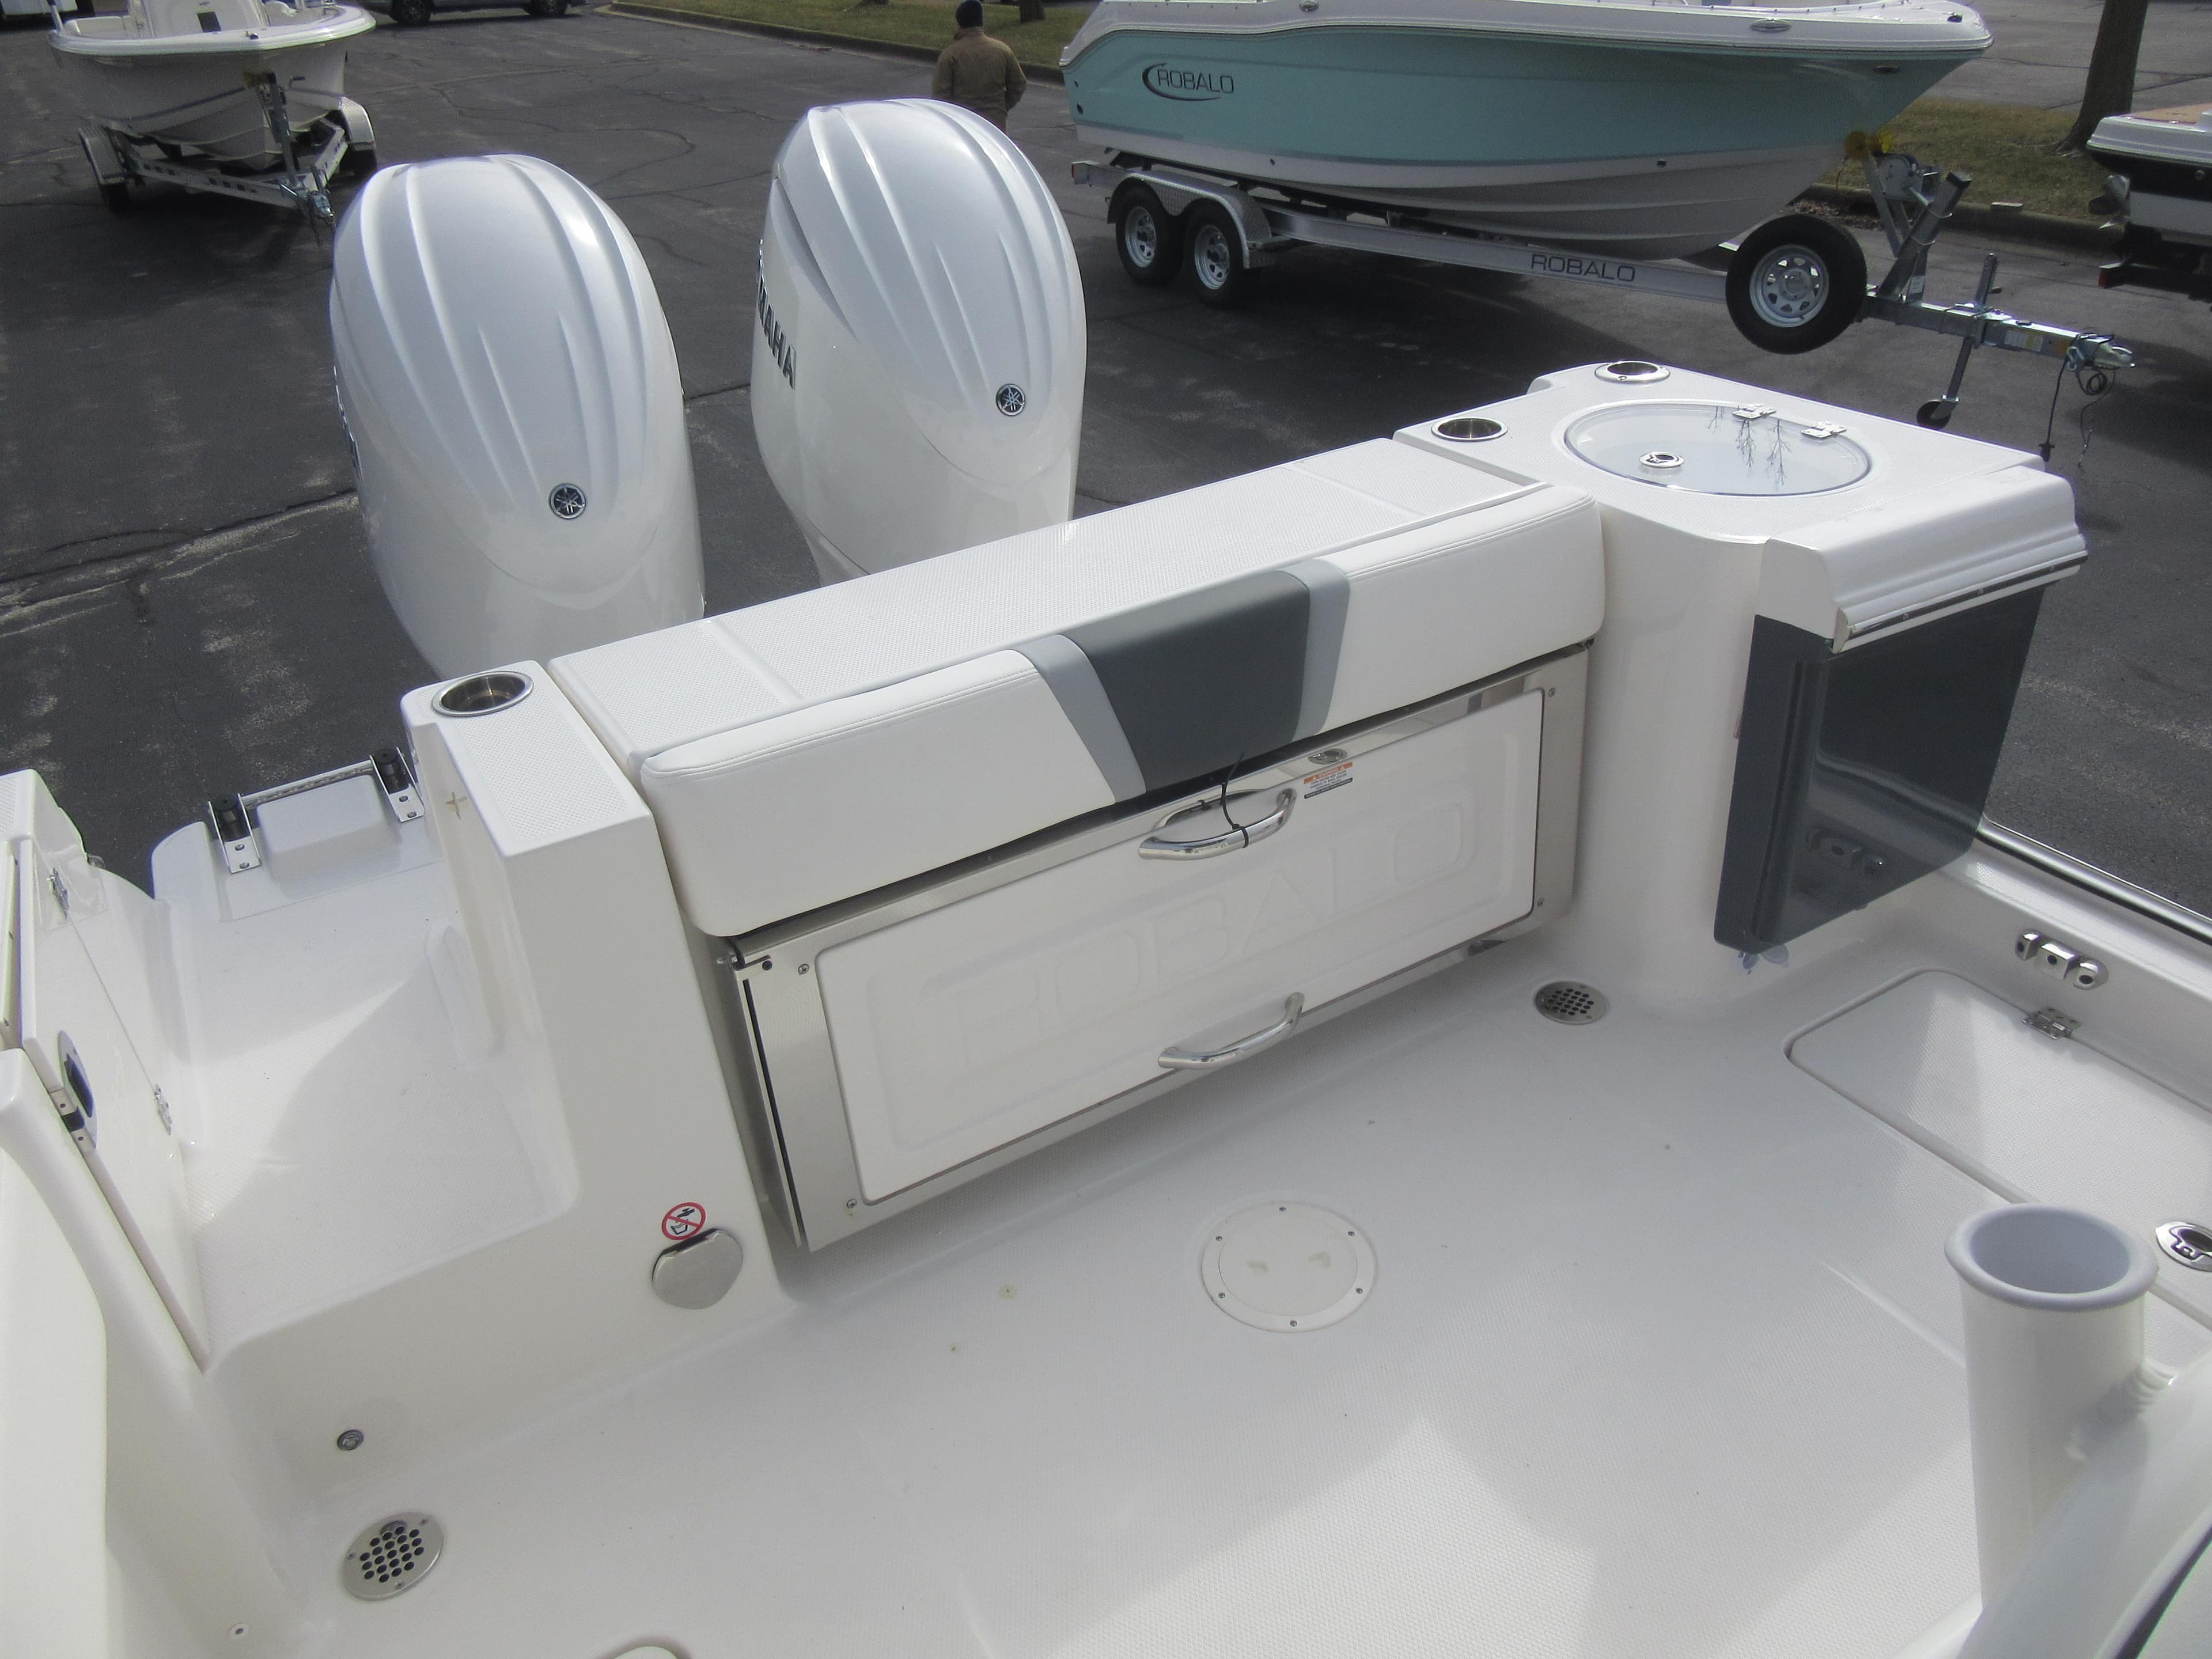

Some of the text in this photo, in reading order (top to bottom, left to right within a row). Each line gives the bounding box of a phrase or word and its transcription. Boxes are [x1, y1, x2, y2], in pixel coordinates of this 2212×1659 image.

[1157, 68, 1234, 94] ROBALO
[1530, 253, 1636, 282] ROBALO
[757, 238, 797, 391] MAHA
